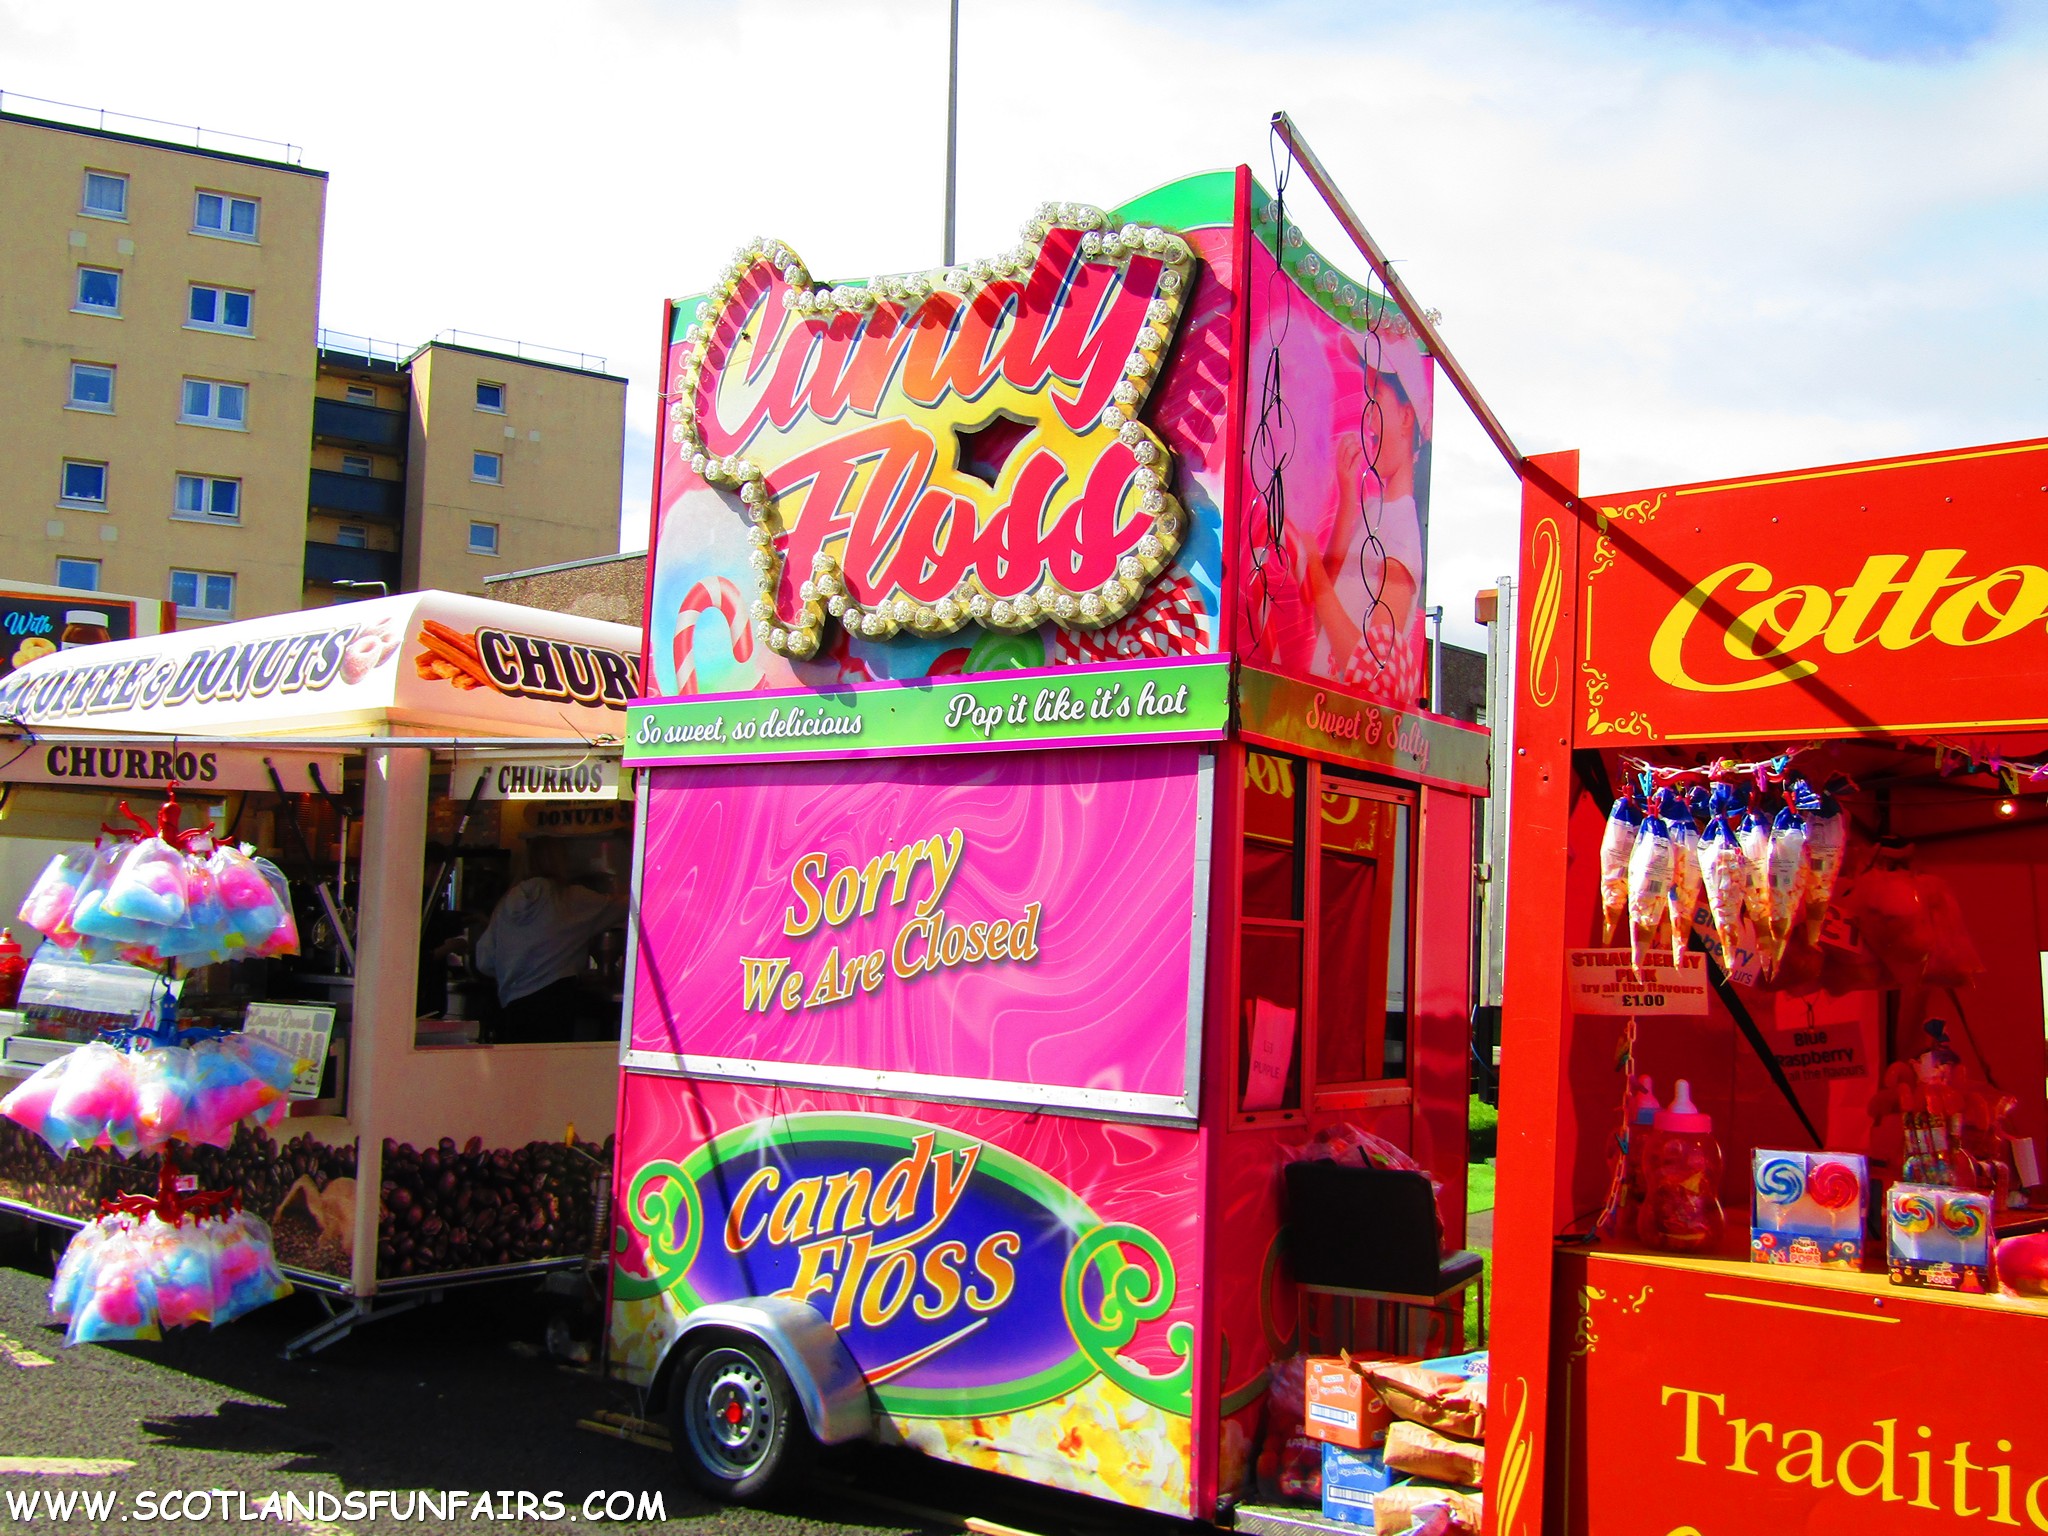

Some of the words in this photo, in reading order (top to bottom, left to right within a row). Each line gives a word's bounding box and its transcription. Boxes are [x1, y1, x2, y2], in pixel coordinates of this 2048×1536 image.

[699, 228, 1165, 457] Candy
[765, 418, 1158, 627] Floss
[4, 611, 53, 635] With
[1649, 549, 2048, 692] Cotto
[141, 661, 175, 709] &
[165, 627, 357, 704] DONUTS
[636, 714, 662, 745] So
[663, 714, 727, 744] sweet,
[731, 720, 756, 740] so
[758, 706, 862, 739] delicious
[944, 692, 1003, 737] Pop
[1007, 693, 1028, 724] it
[1033, 686, 1085, 722] like
[1090, 682, 1131, 719] it's
[1136, 680, 1188, 716] hot
[1306, 692, 1361, 741] Sweet
[1364, 706, 1382, 746] &
[1387, 714, 1430, 772] Salty
[47, 745, 218, 782] CHURROS
[498, 764, 603, 794] CHURROS
[783, 827, 964, 936] Sorry
[740, 956, 804, 1012] We
[803, 946, 886, 1009] Are
[892, 900, 1043, 979] Closed
[1616, 969, 1657, 982] PIK
[1582, 984, 1600, 993] try
[1602, 983, 1620, 993] all
[1622, 982, 1644, 992] the
[1647, 983, 1704, 994] flavours
[1622, 994, 1665, 1007] £1.00
[1794, 1031, 1827, 1047] Blue
[724, 1131, 982, 1260] Candy
[792, 1231, 1020, 1331] Floss
[1790, 1253, 1820, 1265] POPS
